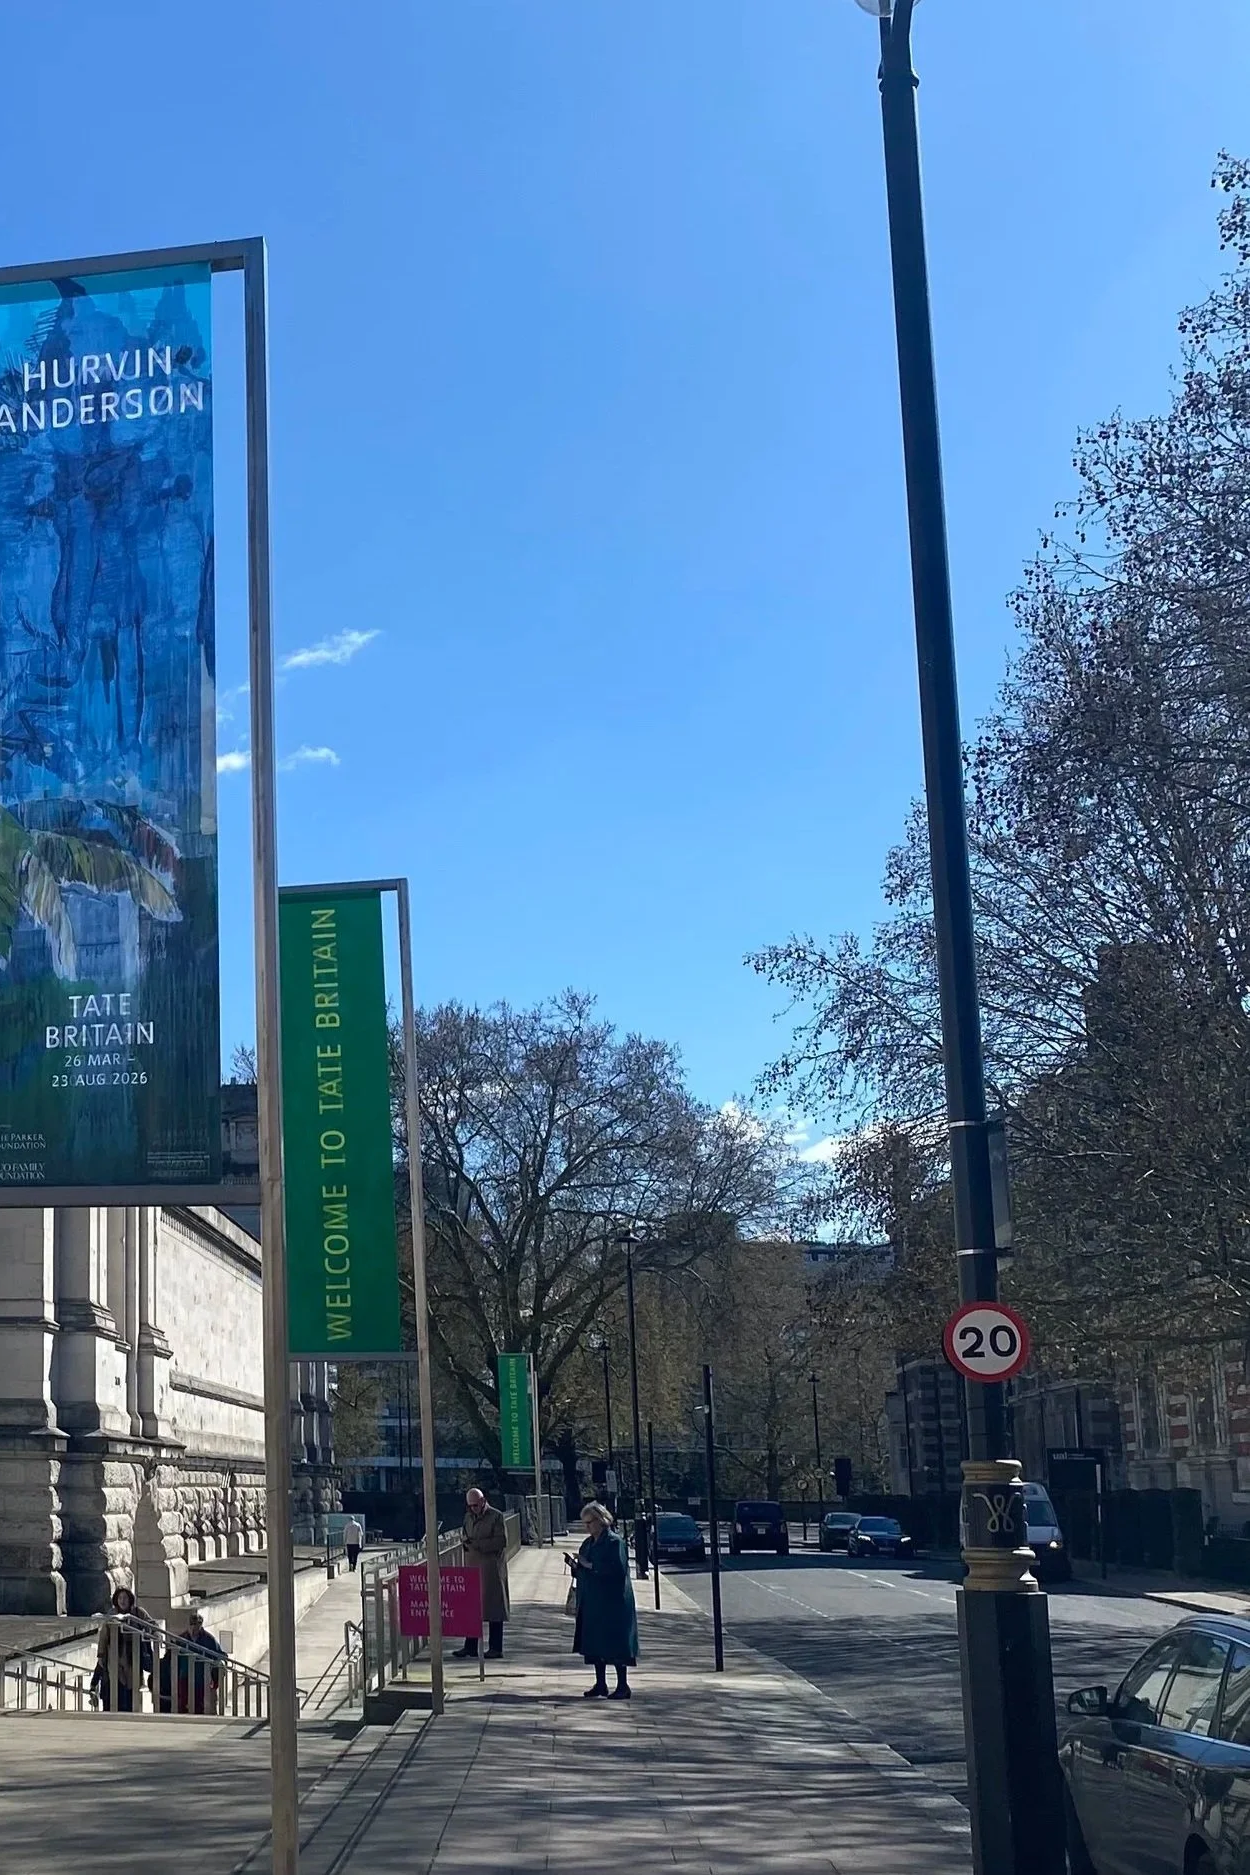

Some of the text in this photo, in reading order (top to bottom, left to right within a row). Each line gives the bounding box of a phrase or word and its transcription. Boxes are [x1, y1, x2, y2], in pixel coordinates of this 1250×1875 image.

[23, 346, 172, 392] HURVIN
[68, 993, 131, 1018] TATE
[46, 1021, 154, 1048] BRITAIN
[64, 1055, 81, 1067] 26
[87, 1053, 121, 1066] MAR
[52, 1072, 148, 1087] 23 AUG 2026
[10, 1133, 44, 1141] PARKER
[311, 909, 352, 1341] WELCOME TO TATE BRITAIN
[959, 1325, 1017, 1359] 20
[409, 1575, 464, 1583] WELME TO
